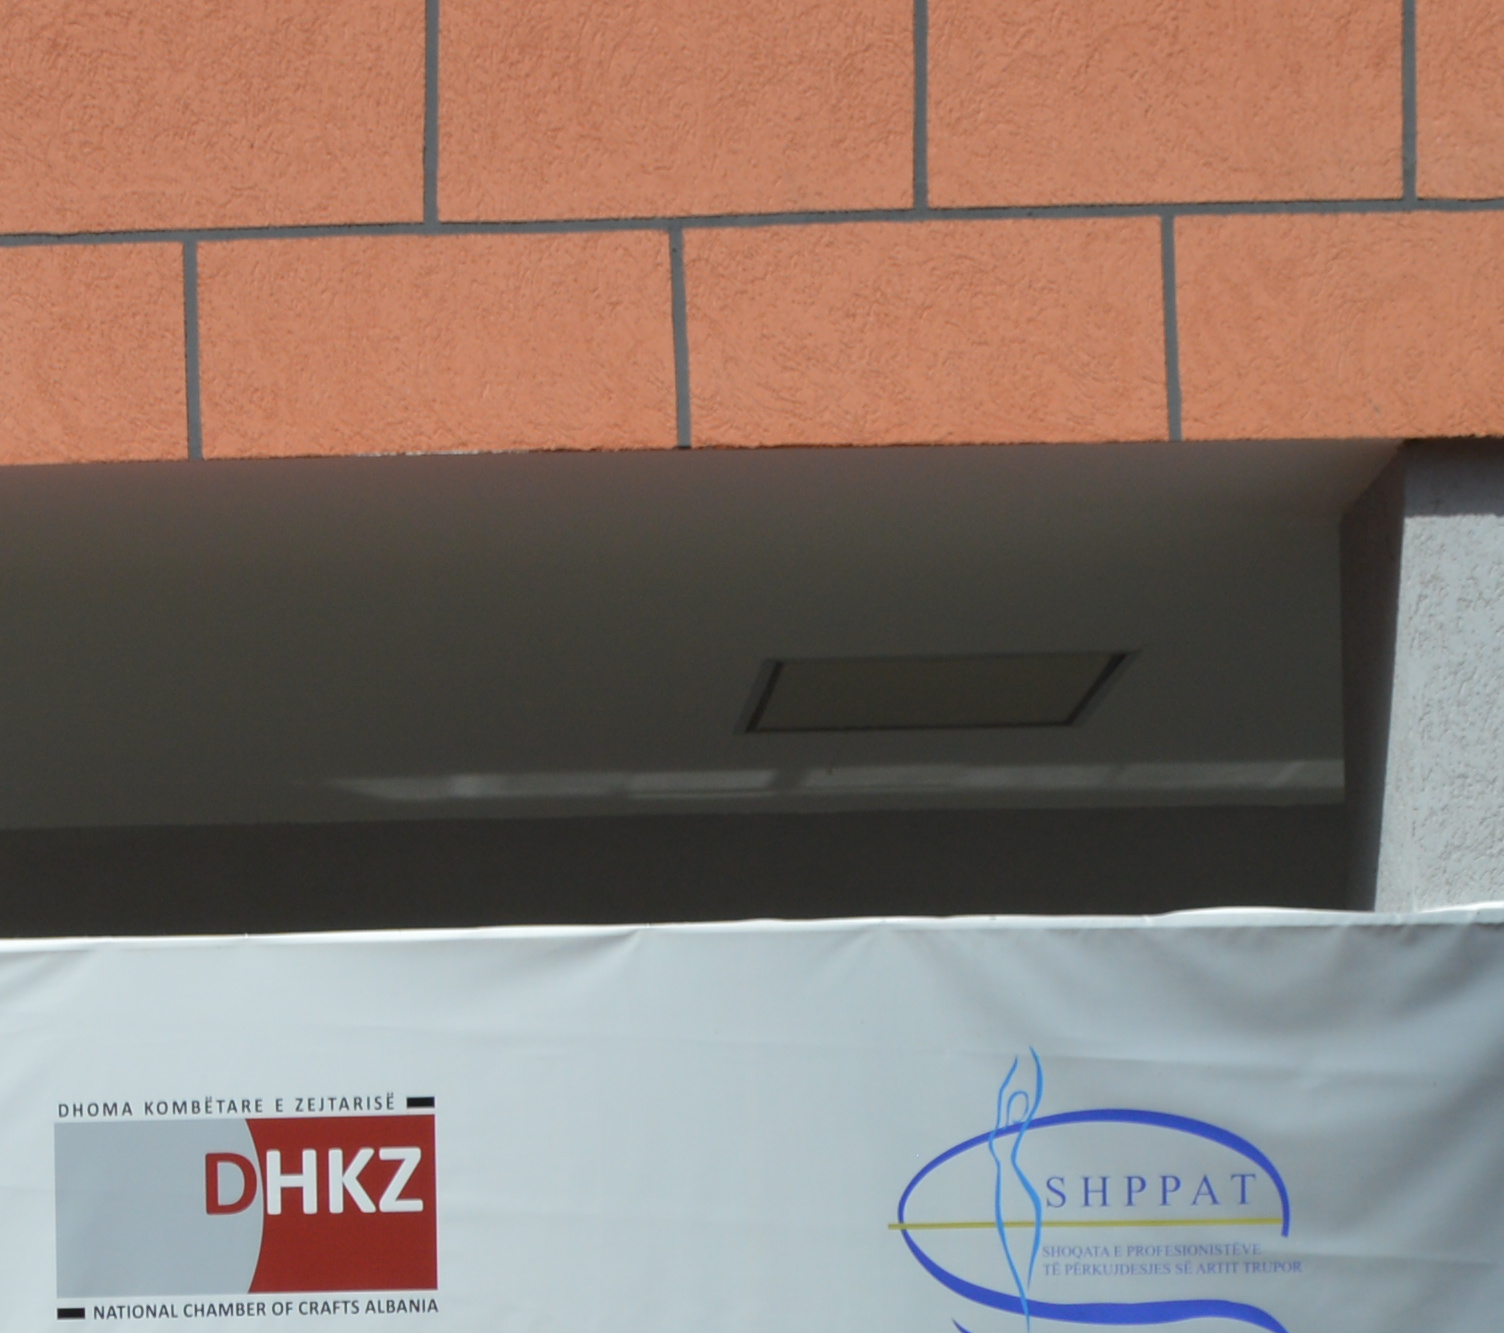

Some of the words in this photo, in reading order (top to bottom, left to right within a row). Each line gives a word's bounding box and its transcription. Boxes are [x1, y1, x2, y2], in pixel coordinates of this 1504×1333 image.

[58, 1101, 133, 1118] DHOMA
[144, 1096, 264, 1117] KOMBËTARE
[275, 1098, 284, 1114] E
[295, 1093, 397, 1114] ZEJTARISË
[205, 1147, 424, 1216] DHKZ
[1045, 1174, 1258, 1210] SHPPAT
[1042, 1246, 1109, 1259] SHOQATA
[1114, 1245, 1121, 1257] E
[1126, 1242, 1262, 1258] PROFESIONISTËVE
[1244, 1259, 1303, 1274] TRUPOR
[93, 1303, 179, 1321] NATIONAL
[183, 1301, 267, 1319] CHAMBER
[272, 1301, 294, 1317] OF
[298, 1299, 361, 1316] CRAFTS
[364, 1298, 440, 1315] ALBANIA
